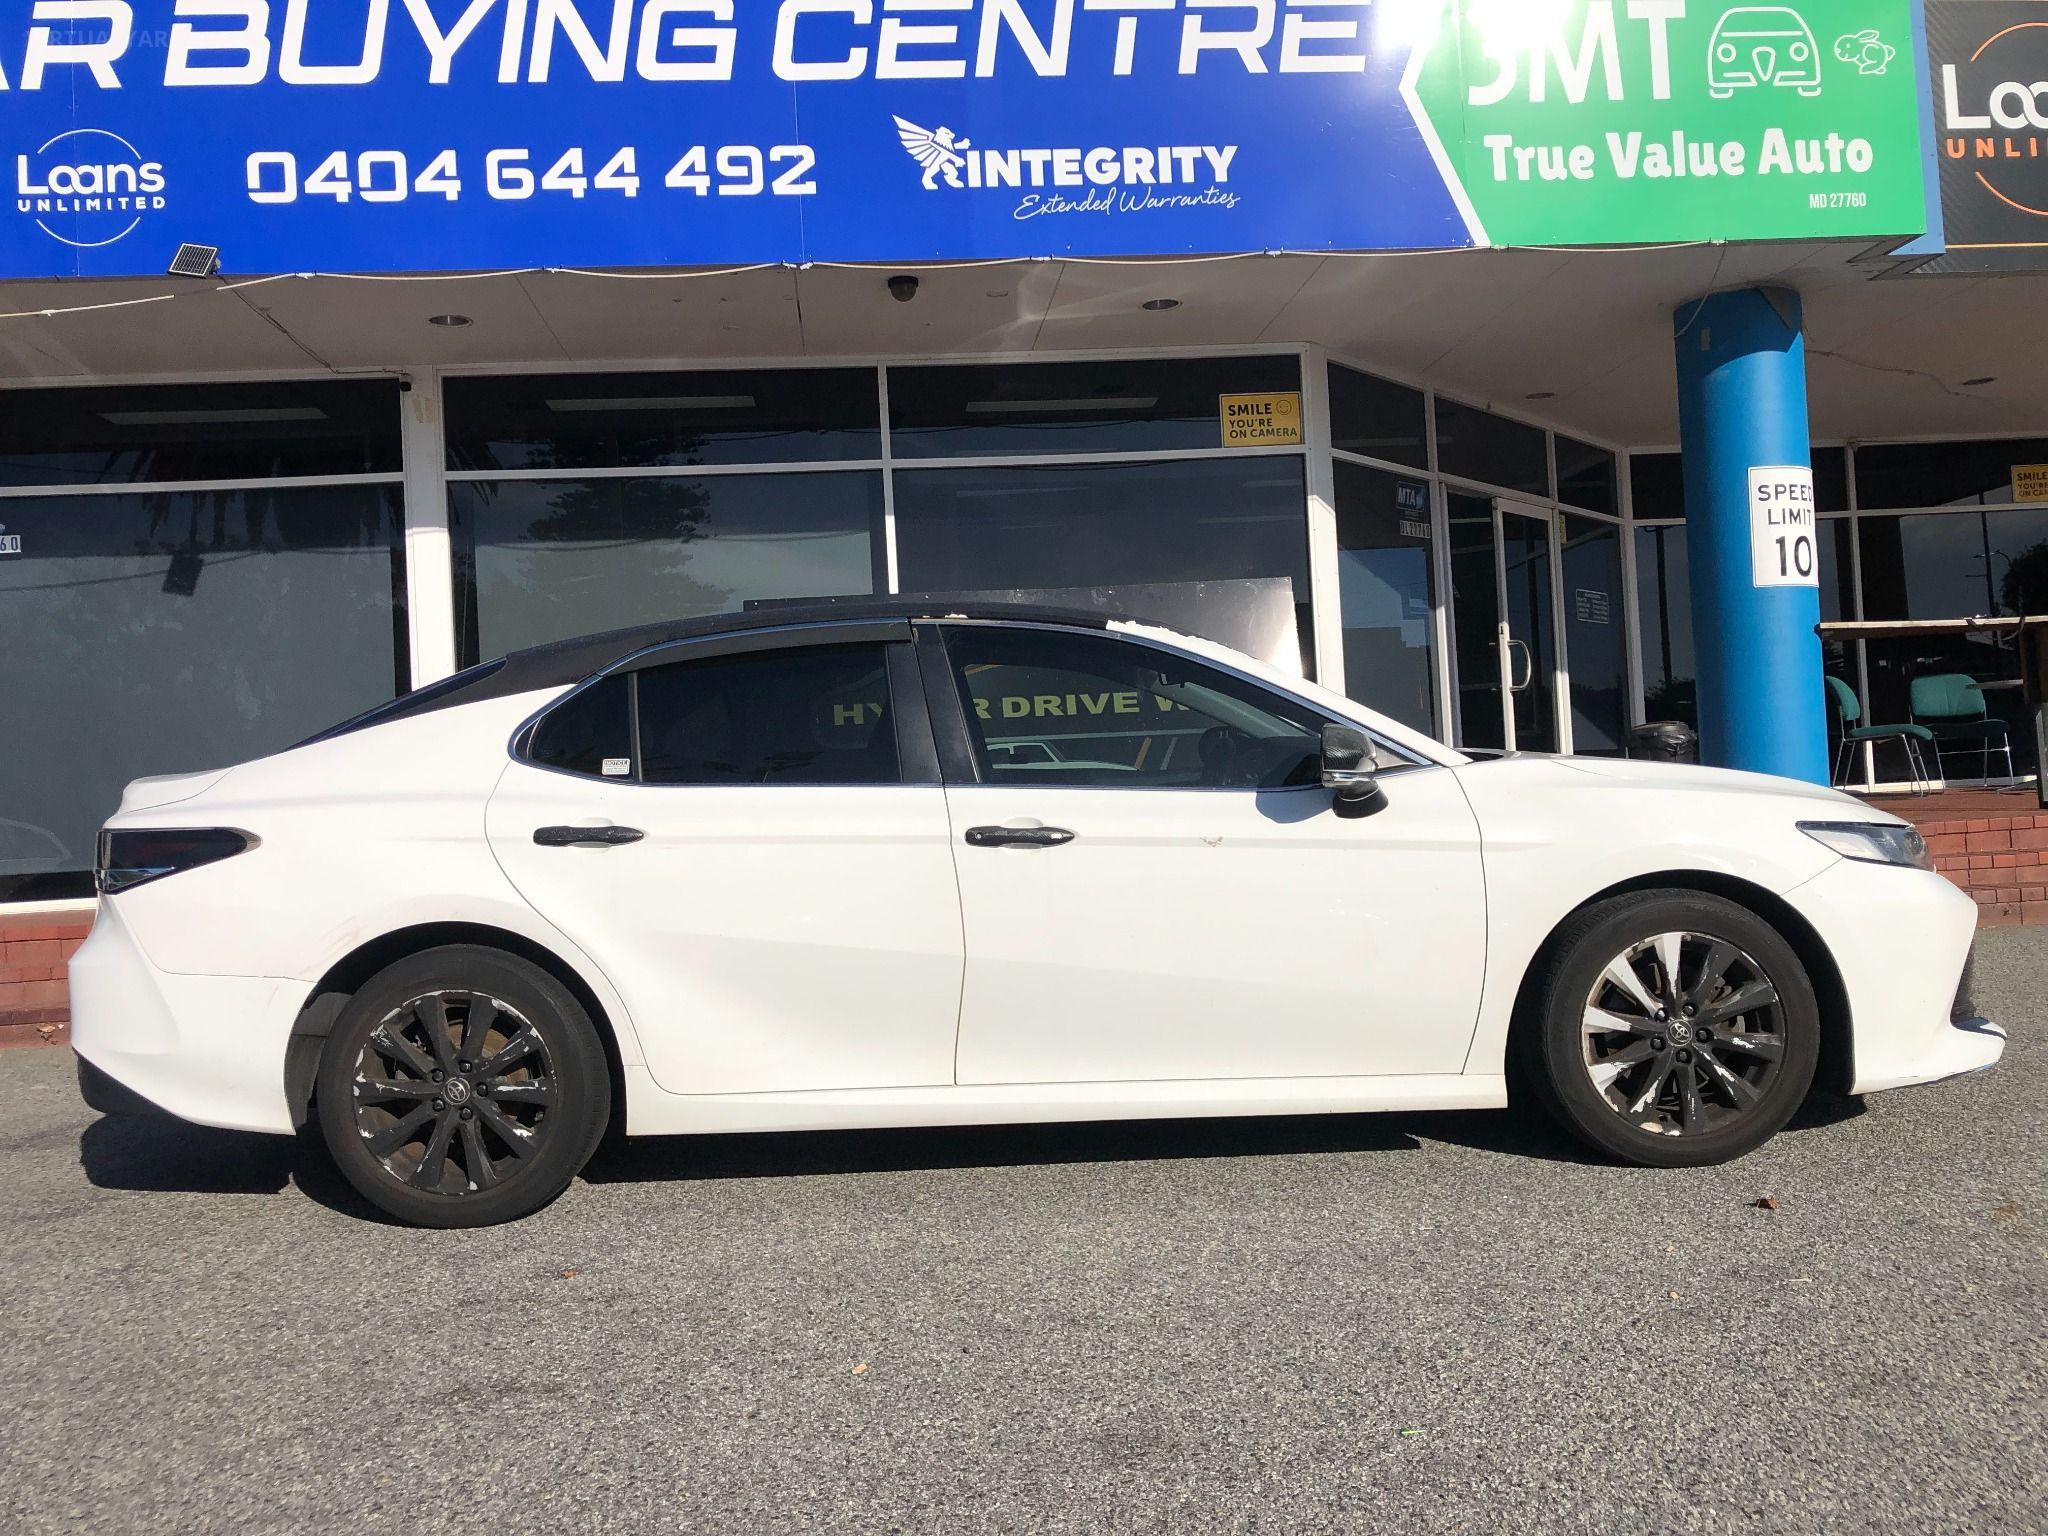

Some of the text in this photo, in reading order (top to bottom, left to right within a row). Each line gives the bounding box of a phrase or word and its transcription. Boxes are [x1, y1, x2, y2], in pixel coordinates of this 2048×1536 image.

[163, 0, 739, 88] BUYING
[771, 0, 1372, 81] CENTRE
[1483, 127, 1873, 181] True Value Auto
[1946, 137, 2048, 159] UNLI
[18, 154, 165, 194] Loans
[246, 145, 817, 204] 0404 644 492
[966, 145, 1238, 189] INTEGRITY
[18, 196, 165, 212] UNLIMITED
[1013, 185, 1241, 221] Extended Warranties
[1809, 192, 1867, 209] MD 27760
[1228, 403, 1273, 416] SMILE
[1229, 418, 1273, 429] YOU'RE
[1229, 427, 1298, 439] ON CAMERA
[1767, 507, 1812, 526] LIMIT
[0, 536, 18, 551] 60
[1775, 535, 1813, 577] 10
[1003, 692, 1140, 718] DRIVE
